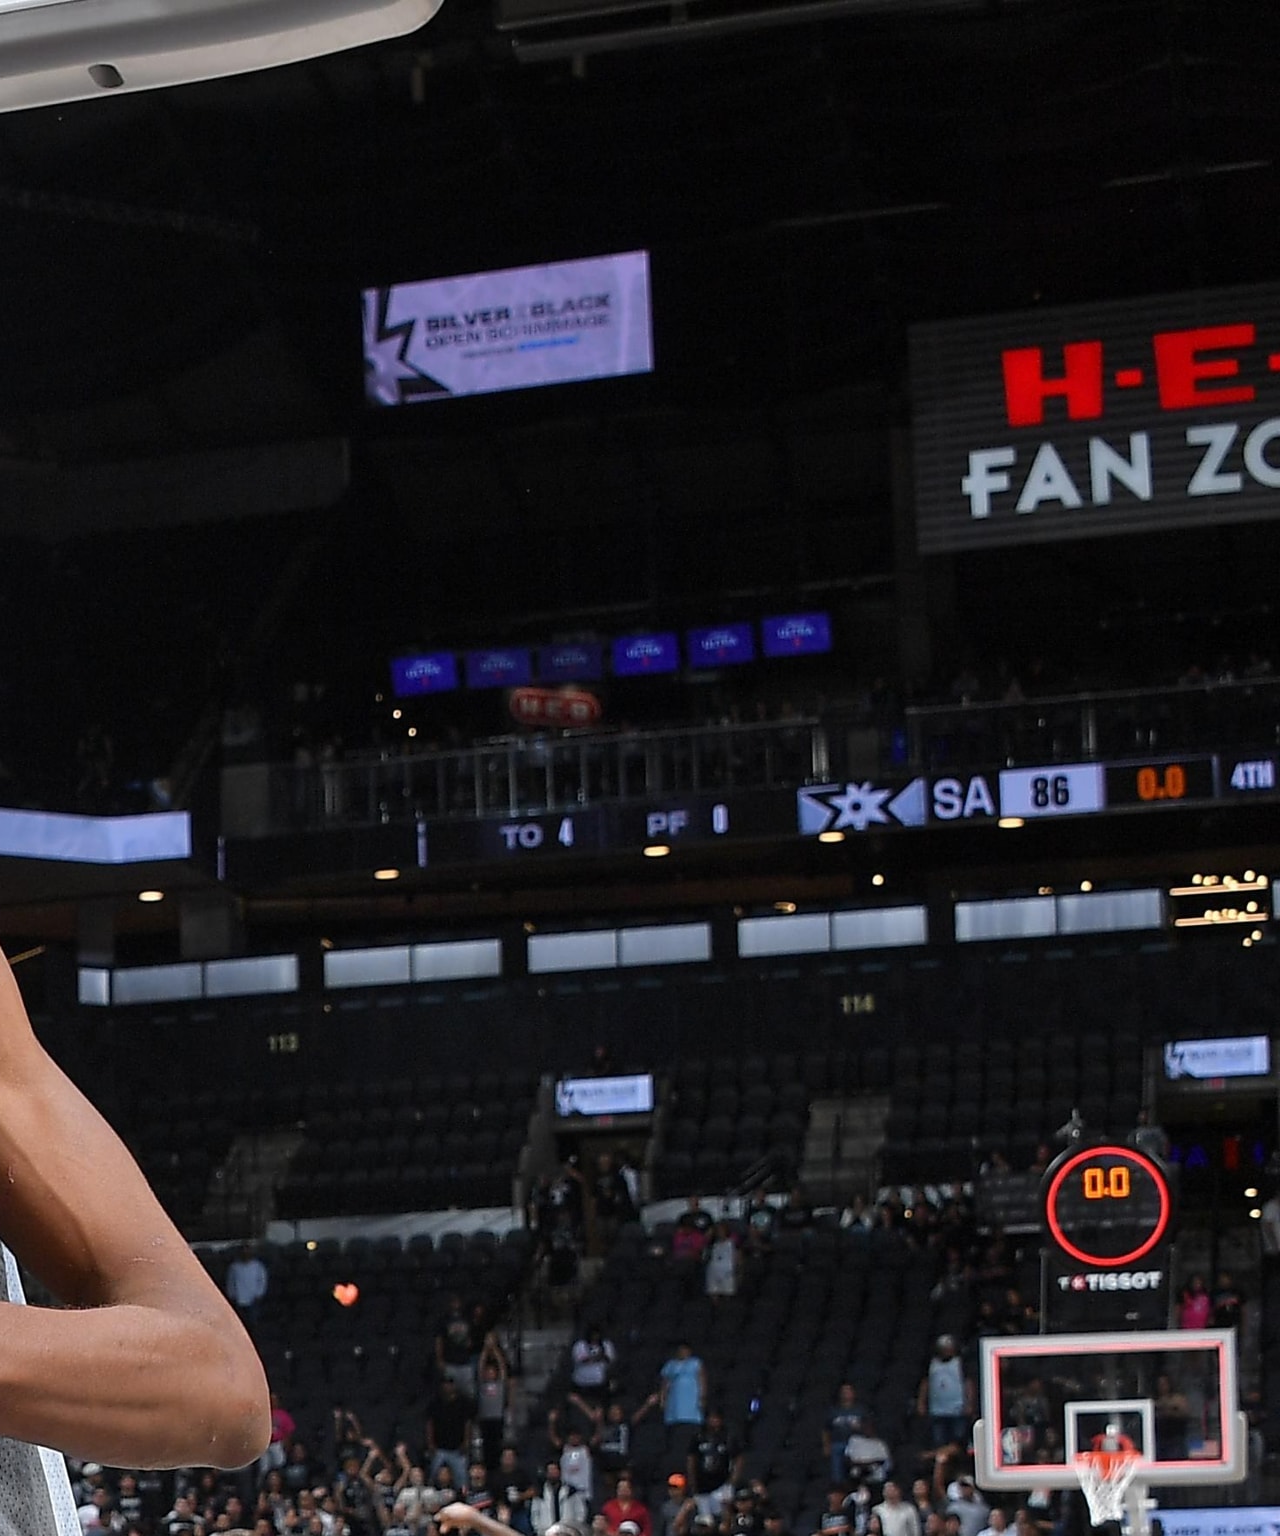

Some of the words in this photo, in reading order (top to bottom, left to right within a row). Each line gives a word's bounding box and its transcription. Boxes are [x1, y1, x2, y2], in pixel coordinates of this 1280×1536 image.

[961, 431, 1153, 519] FAN
[933, 775, 996, 820] SA
[1029, 774, 1070, 809] 86
[1136, 764, 1187, 801] 0.0
[1230, 759, 1276, 791] 4TH
[500, 823, 544, 850] TO
[558, 816, 575, 848] 4
[646, 809, 689, 837] PF
[1083, 1166, 1131, 1199] 0.0
[1085, 1271, 1163, 1291] TISSOT
